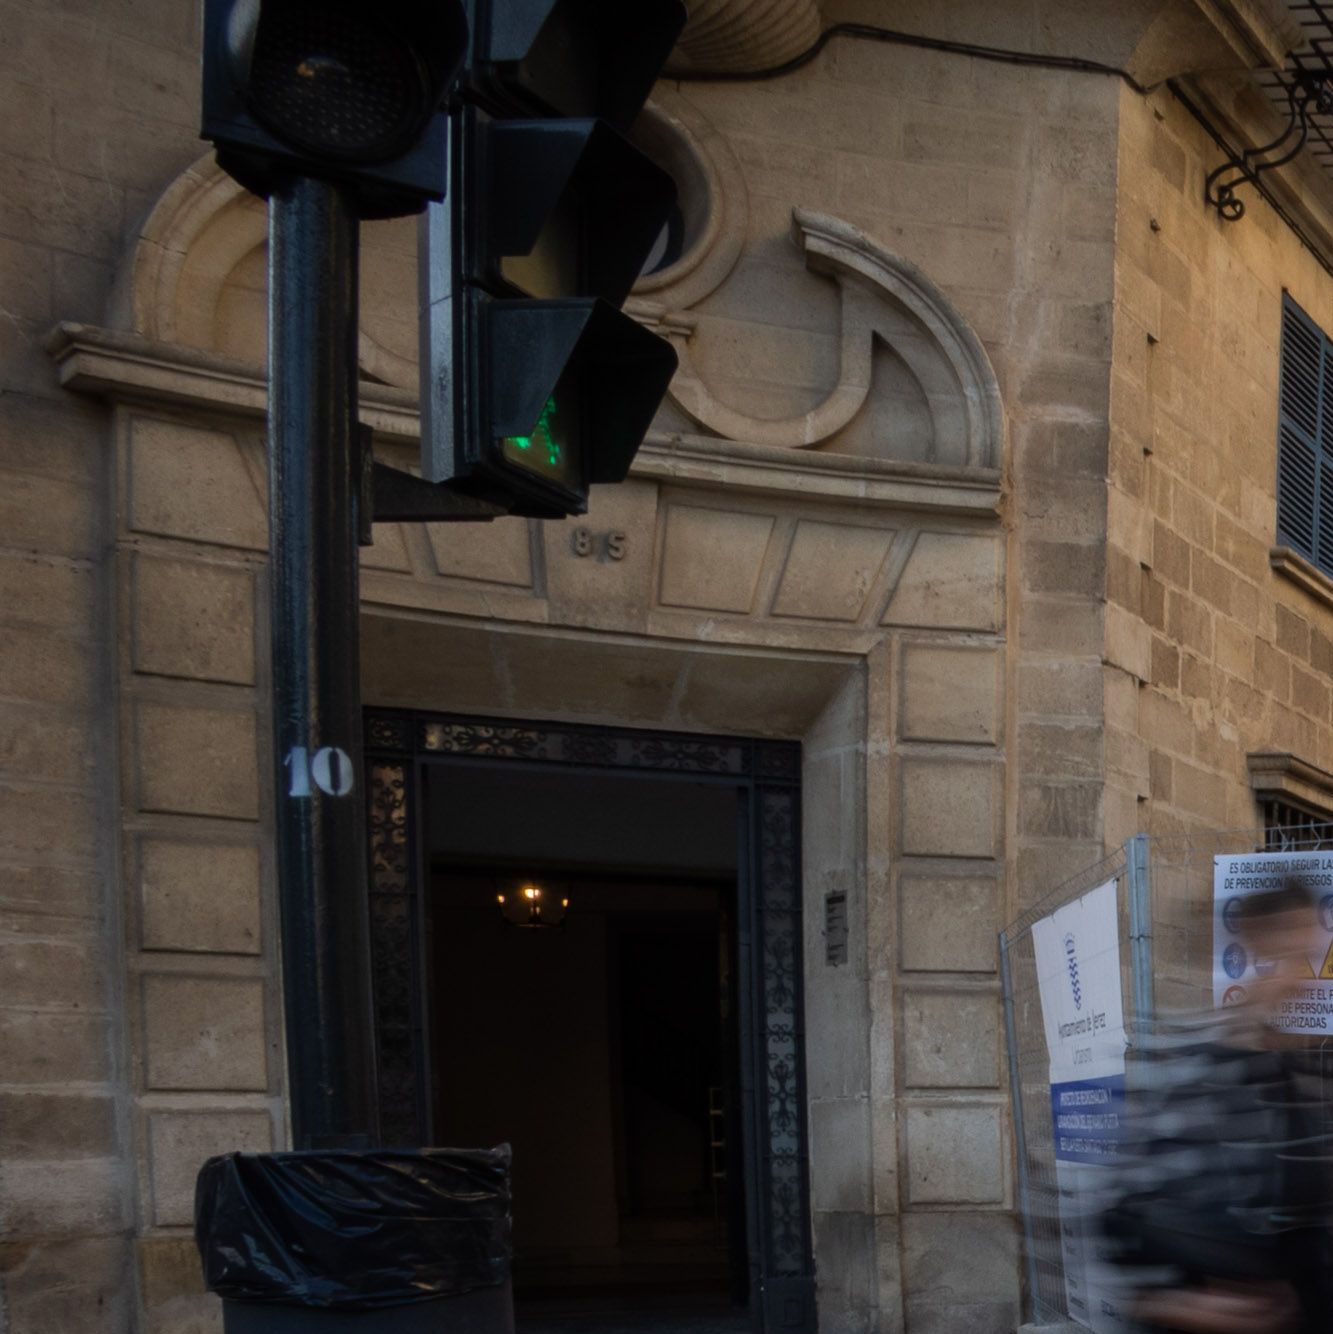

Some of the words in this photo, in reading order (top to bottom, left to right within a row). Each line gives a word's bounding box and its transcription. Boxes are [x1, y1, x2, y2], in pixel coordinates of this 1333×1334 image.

[573, 528, 626, 561] 85
[284, 746, 354, 797] 10
[1230, 862, 1239, 874] ES
[1240, 860, 1289, 874] OBLIGATORIO
[1291, 858, 1320, 872] SEGUIR
[1224, 878, 1234, 889] DE
[1317, 989, 1327, 1001] EL
[1281, 1002, 1293, 1014] DE
